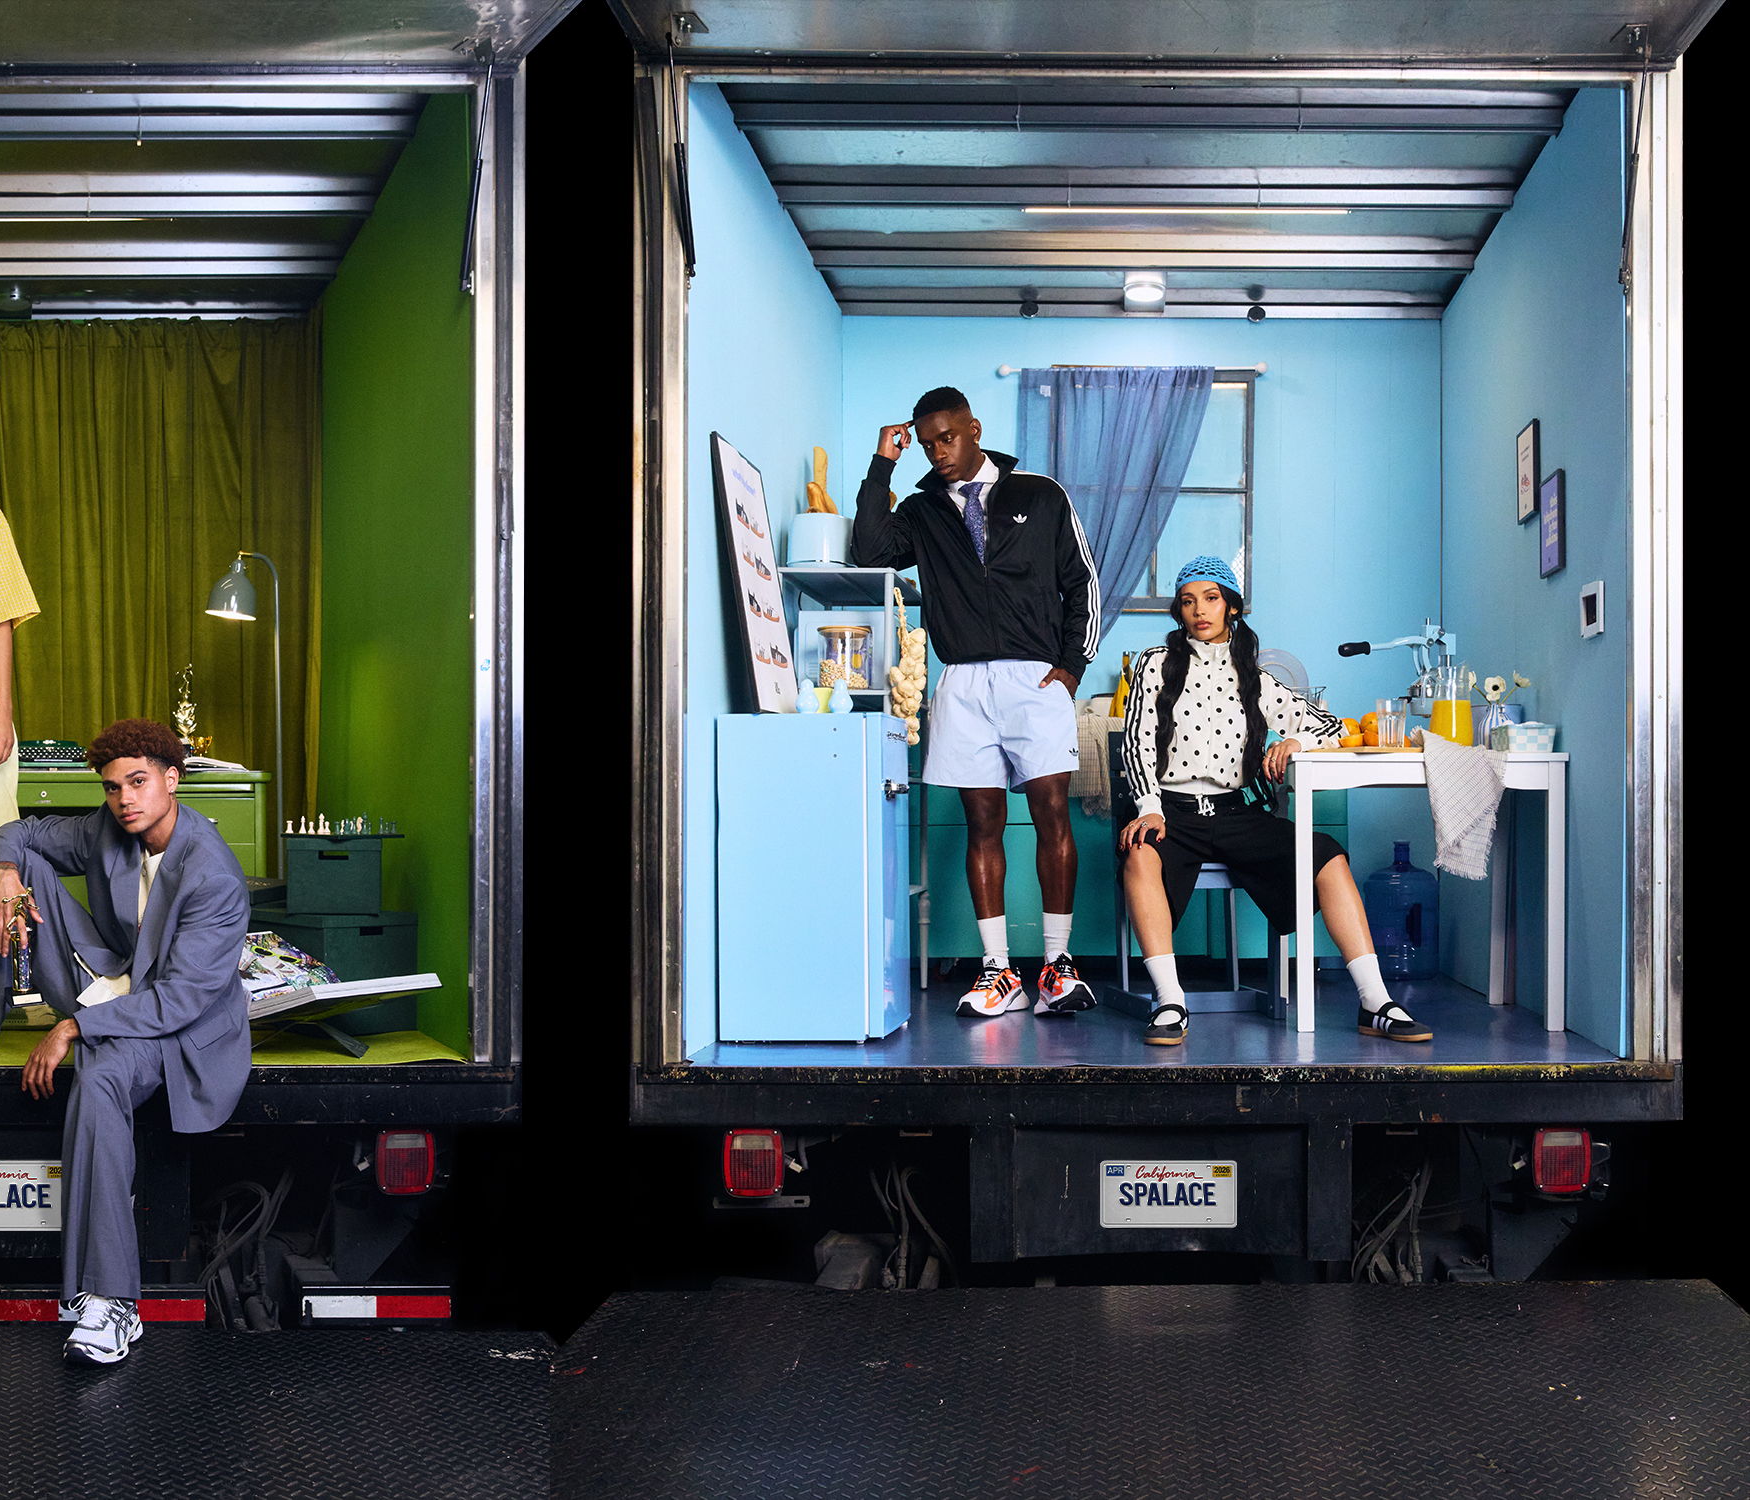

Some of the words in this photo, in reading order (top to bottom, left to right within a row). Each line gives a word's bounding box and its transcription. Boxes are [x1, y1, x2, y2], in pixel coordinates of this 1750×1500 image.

[1135, 1165, 1203, 1182] California
[1214, 1166, 1230, 1174] 2026
[1118, 1182, 1217, 1206] SPALACE
